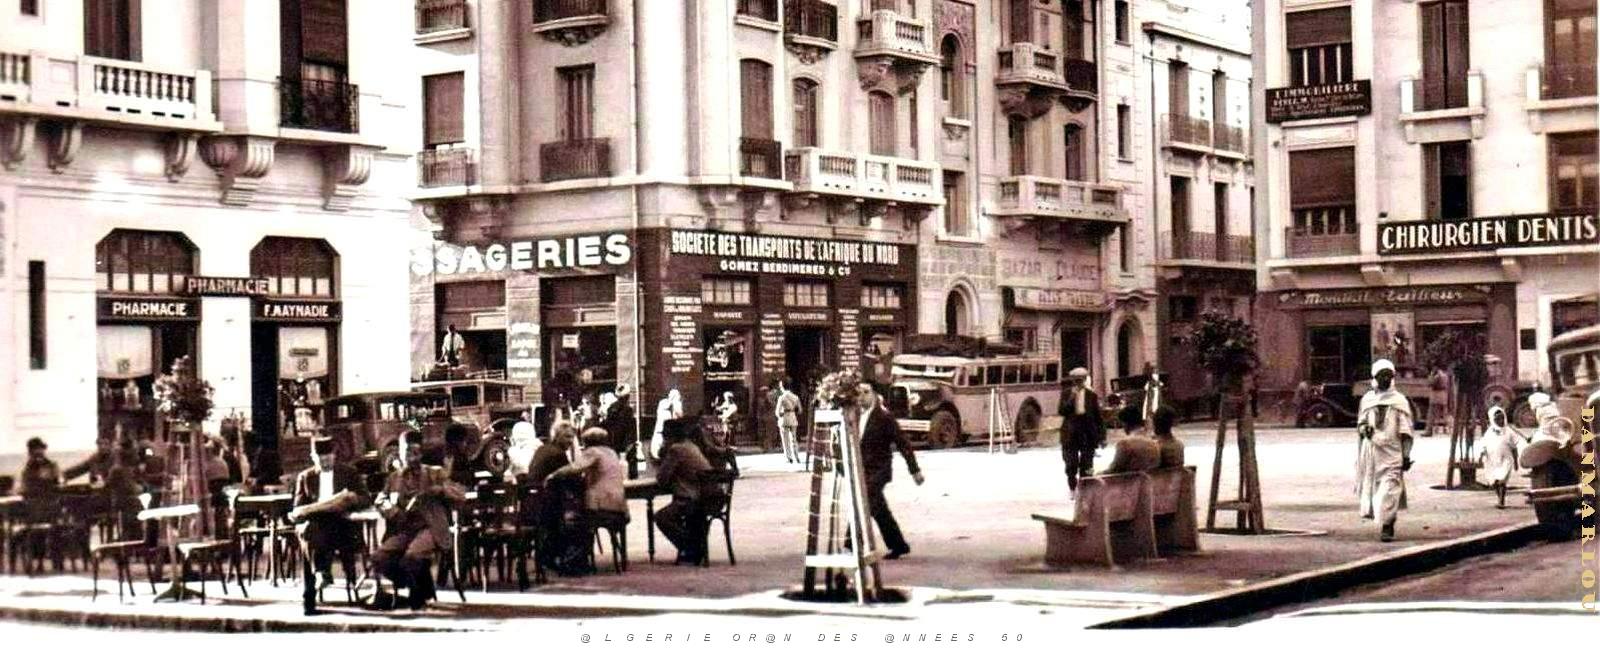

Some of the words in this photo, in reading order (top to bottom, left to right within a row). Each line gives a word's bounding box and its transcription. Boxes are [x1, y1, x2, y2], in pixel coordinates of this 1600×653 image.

[1382, 220, 1506, 249] CHIRURGIEN
[1518, 215, 1597, 243] DENTIS
[672, 231, 716, 255] SOCIETE
[718, 233, 737, 256] DES
[739, 235, 801, 260] TRANSPORTS
[804, 239, 815, 260] DE
[862, 243, 874, 263] DU
[876, 245, 899, 265] NORD
[720, 259, 759, 272] GOMEZ
[188, 277, 269, 295] PHARMACIE
[112, 302, 187, 316] PHARMACIE
